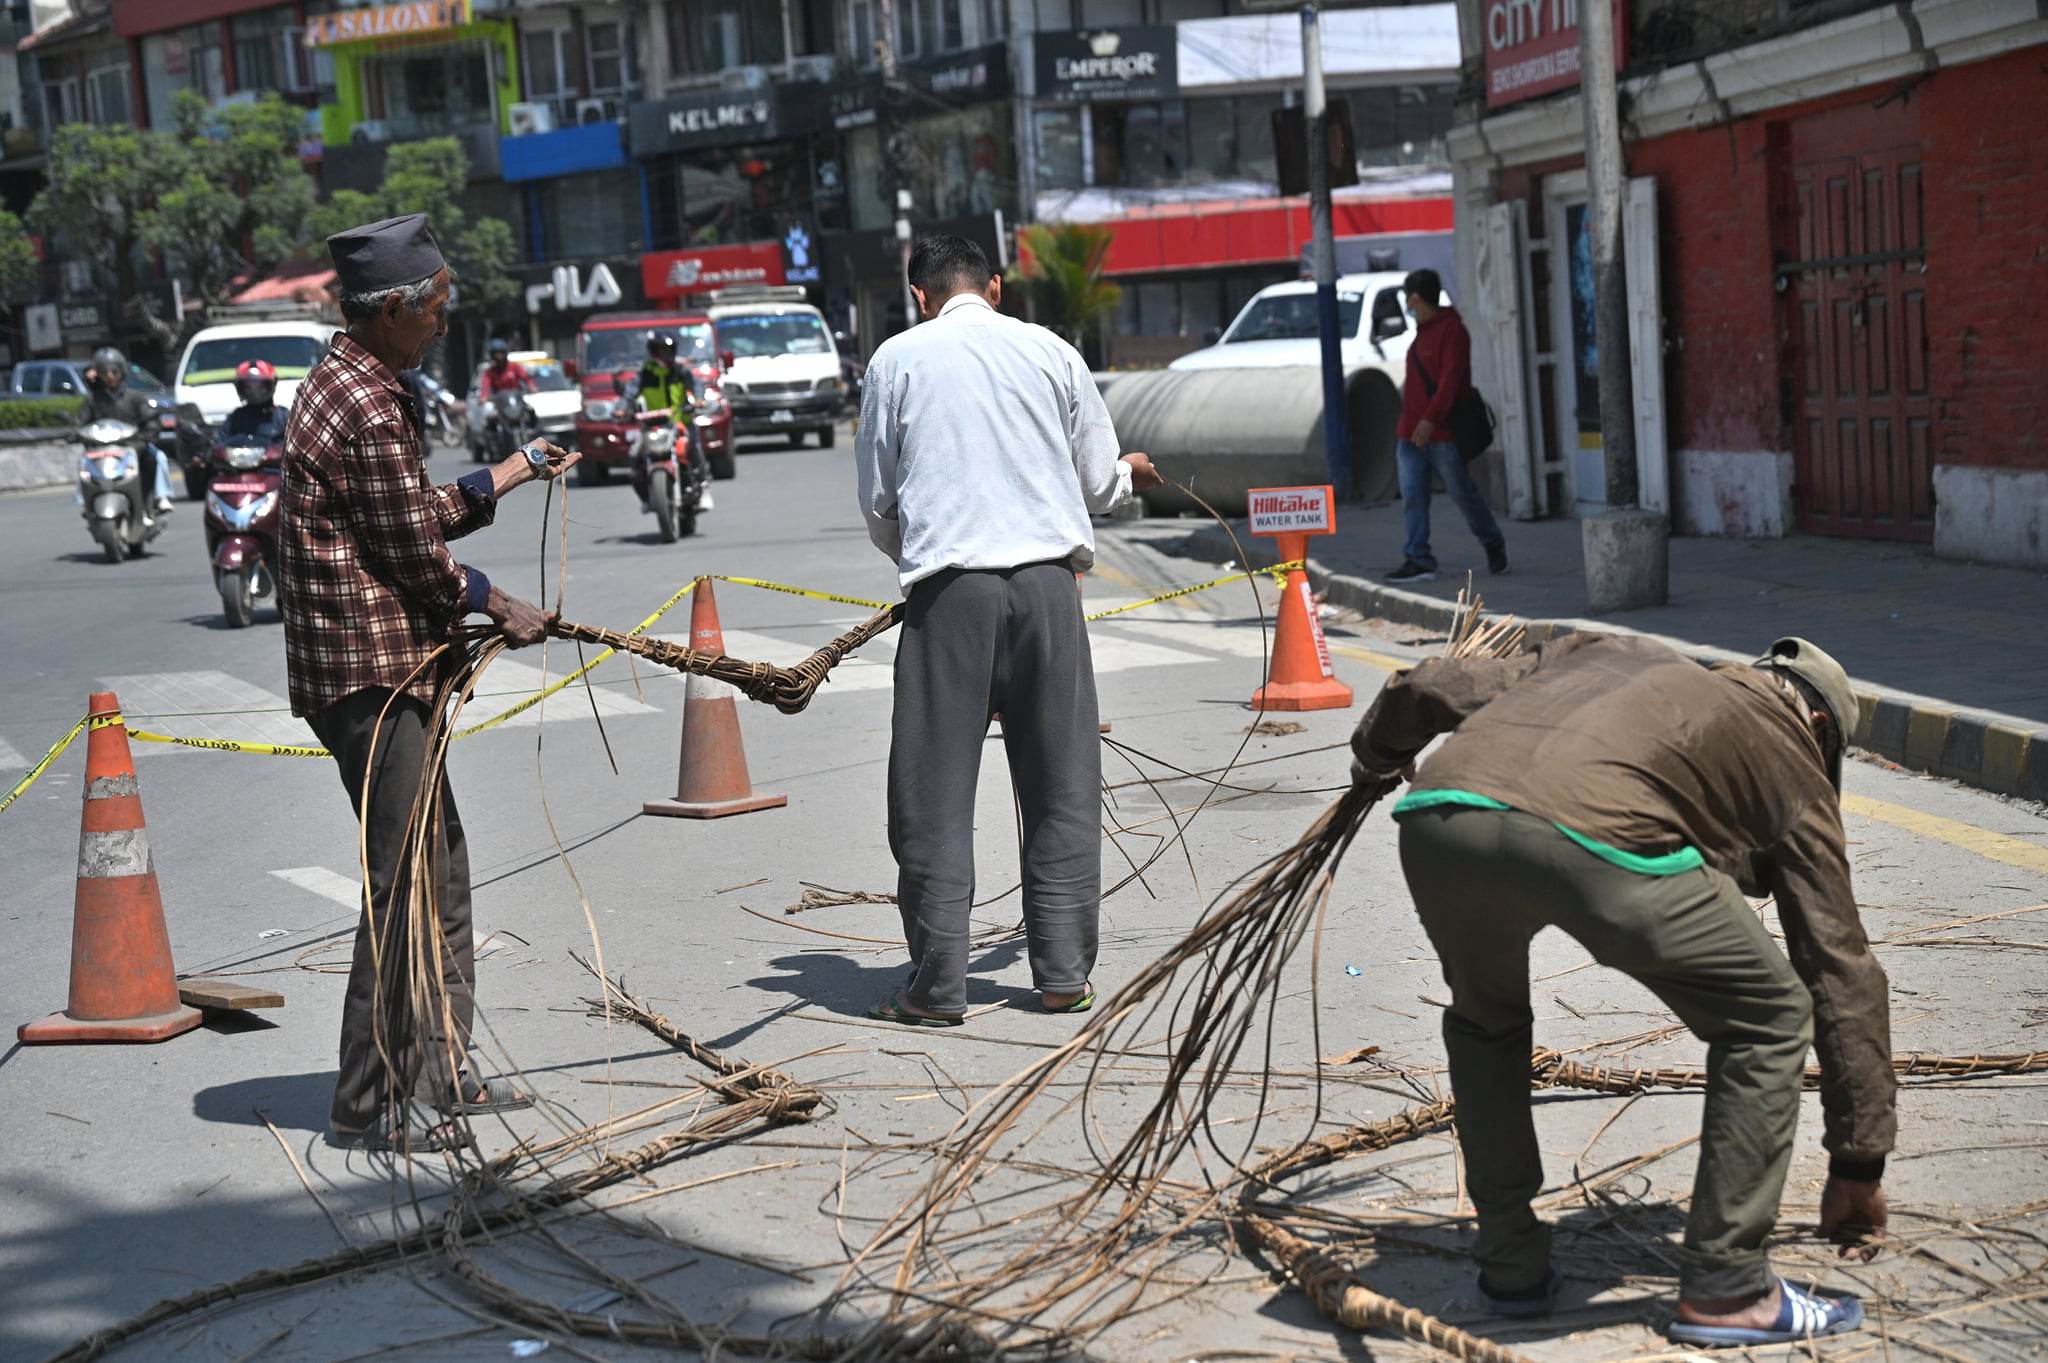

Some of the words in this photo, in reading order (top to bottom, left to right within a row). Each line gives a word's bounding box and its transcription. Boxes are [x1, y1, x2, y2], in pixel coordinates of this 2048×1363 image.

[1488, 0, 1542, 50] CITY
[1055, 51, 1156, 80] EMPEROR
[669, 104, 747, 133] KELME
[526, 262, 622, 314] FILA
[1254, 495, 1321, 514] Hilltake
[1255, 515, 1292, 528] WATER
[1295, 513, 1322, 525] TANK
